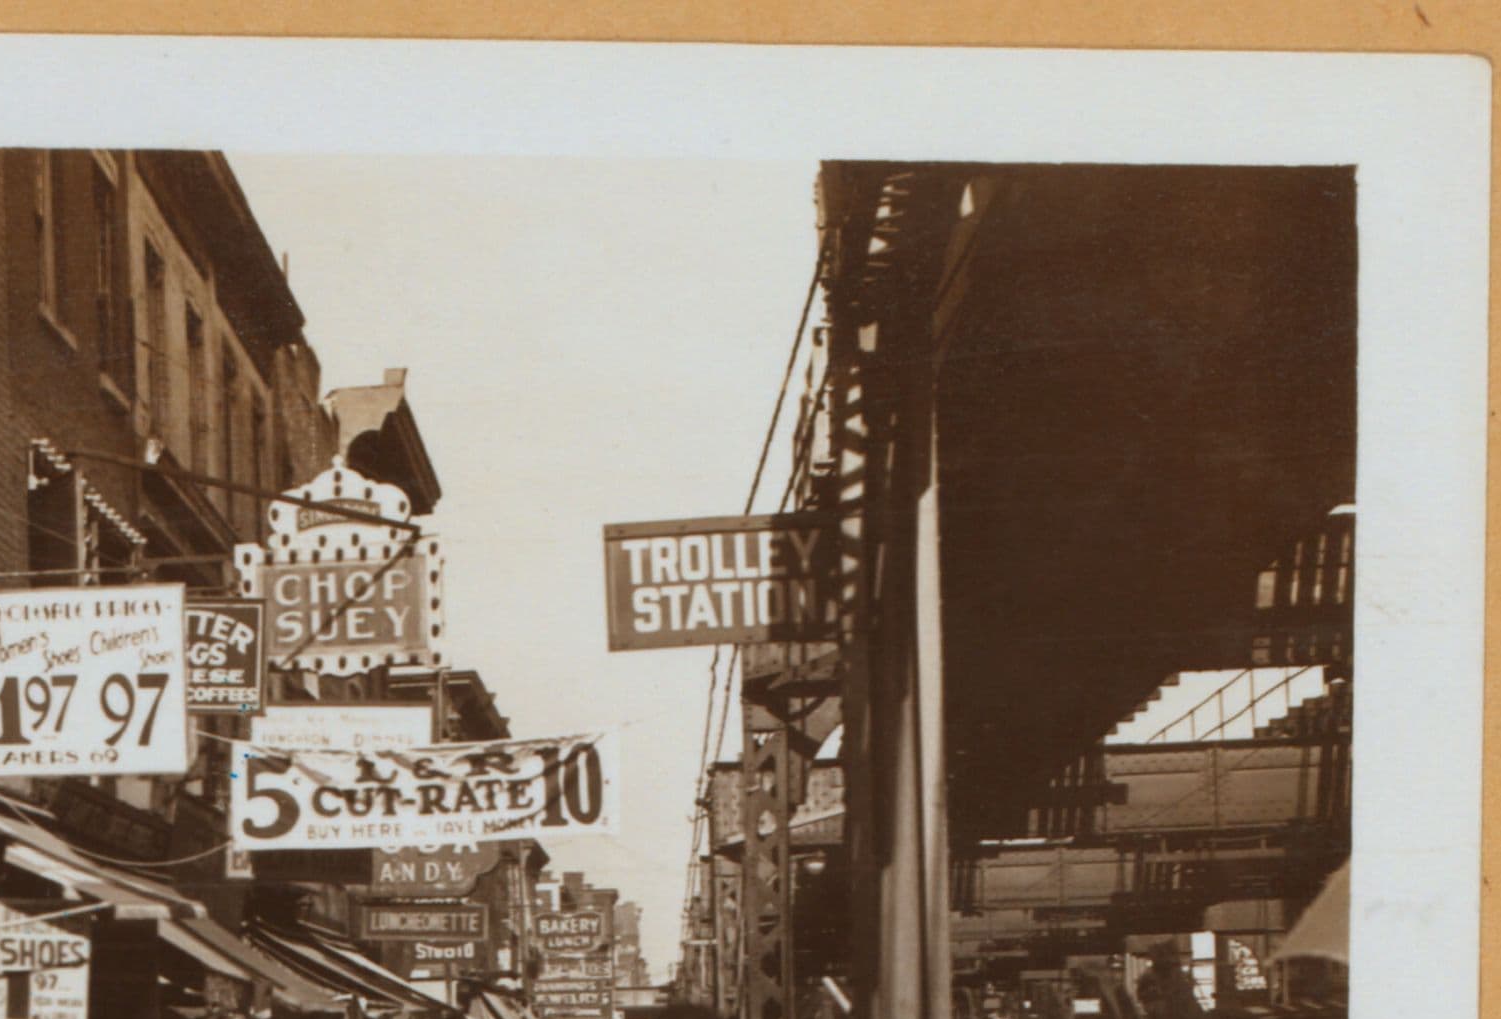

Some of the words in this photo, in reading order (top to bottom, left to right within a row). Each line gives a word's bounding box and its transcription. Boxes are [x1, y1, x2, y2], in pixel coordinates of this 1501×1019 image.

[621, 528, 821, 586] TROLLEY
[274, 570, 410, 606] CHOP
[632, 577, 817, 633] STATION
[276, 606, 411, 643] SUEY
[43, 647, 81, 673] Shoes
[90, 627, 159, 656] Children's
[140, 649, 174, 671] Shoes
[100, 673, 170, 747] 97
[90, 749, 119, 763] 69
[356, 752, 398, 784] L
[242, 756, 301, 839] 5
[312, 780, 534, 818] CUT-RATE
[536, 742, 603, 827] 10
[307, 825, 340, 840] BUY
[352, 822, 401, 839] HERE
[483, 813, 536, 834] MONEY
[371, 912, 479, 932] LUNCHEONETTE
[539, 919, 598, 934] BAKERY
[0, 938, 86, 967] SHOES
[415, 942, 474, 959] Studio
[548, 936, 591, 948] LUNCH
